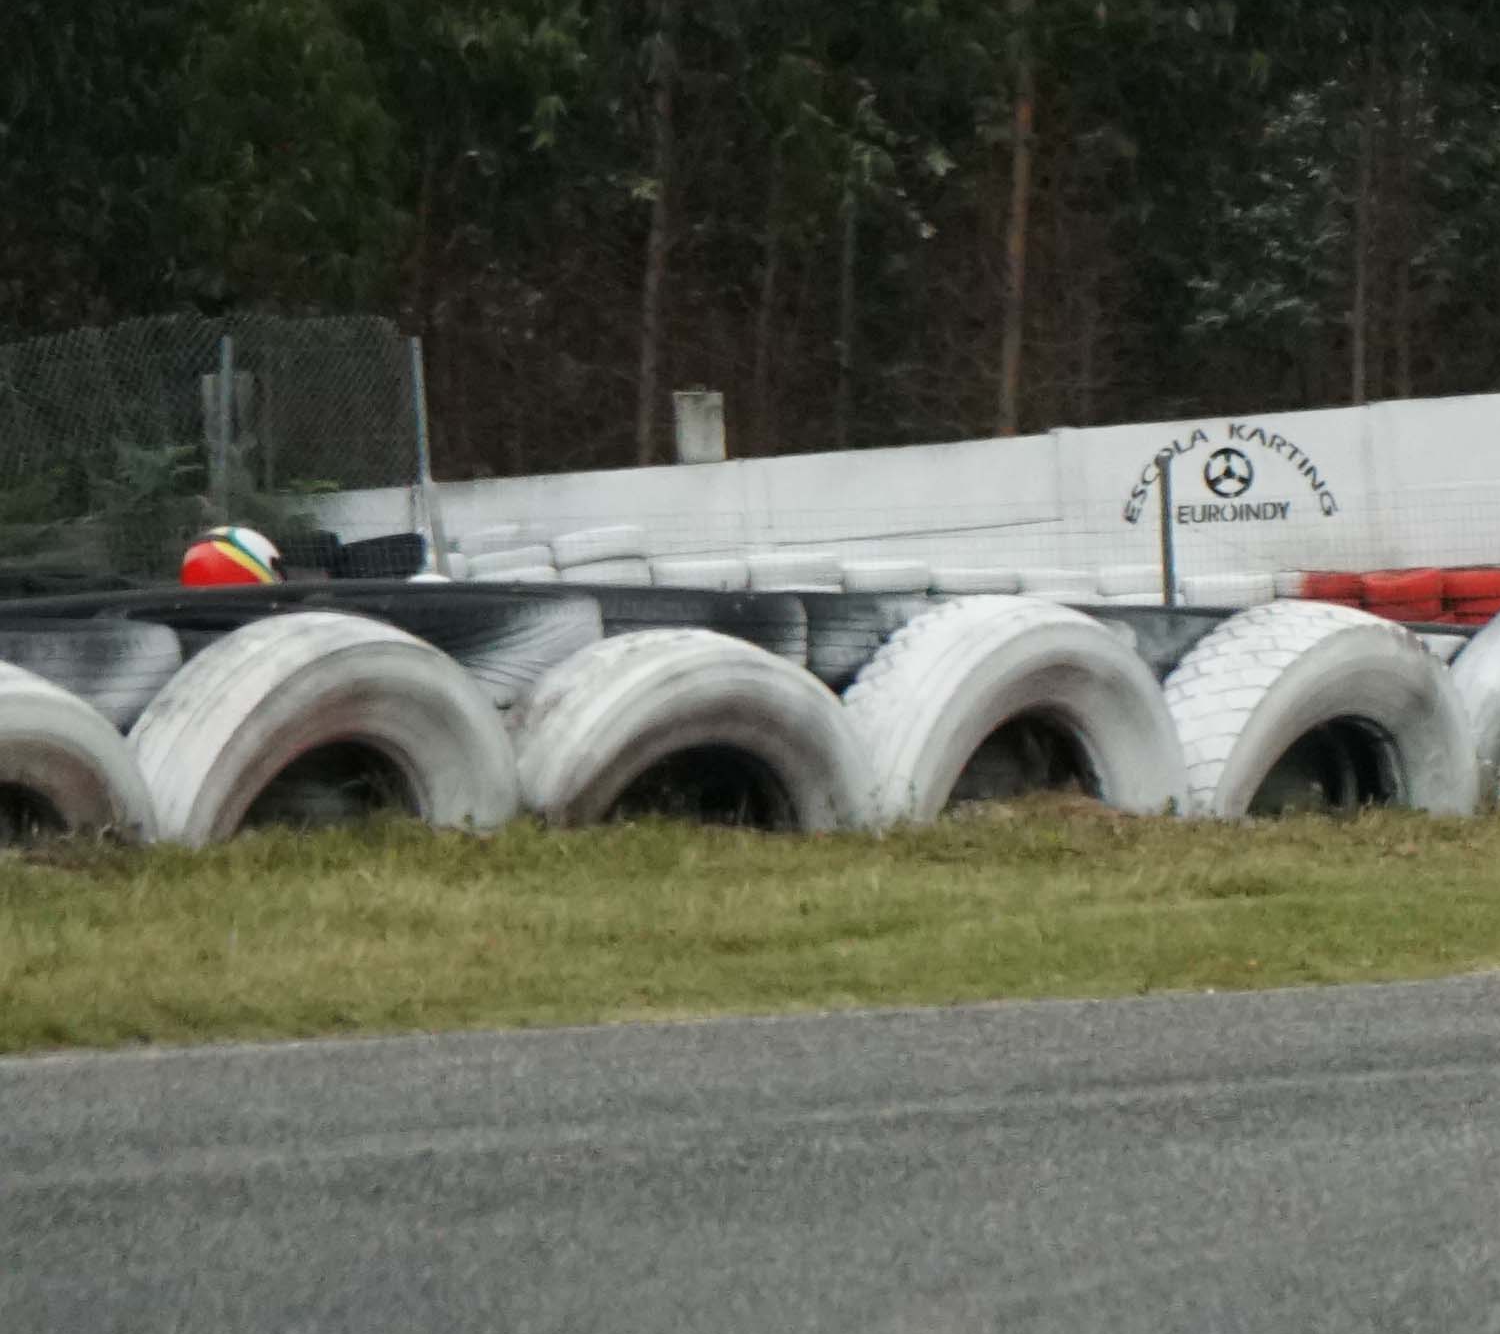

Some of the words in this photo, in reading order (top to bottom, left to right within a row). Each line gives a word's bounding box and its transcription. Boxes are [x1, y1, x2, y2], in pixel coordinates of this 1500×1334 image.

[1123, 428, 1209, 525] ESCOLA
[1229, 424, 1338, 517] KARTING
[1177, 501, 1291, 525] EUROINDY
